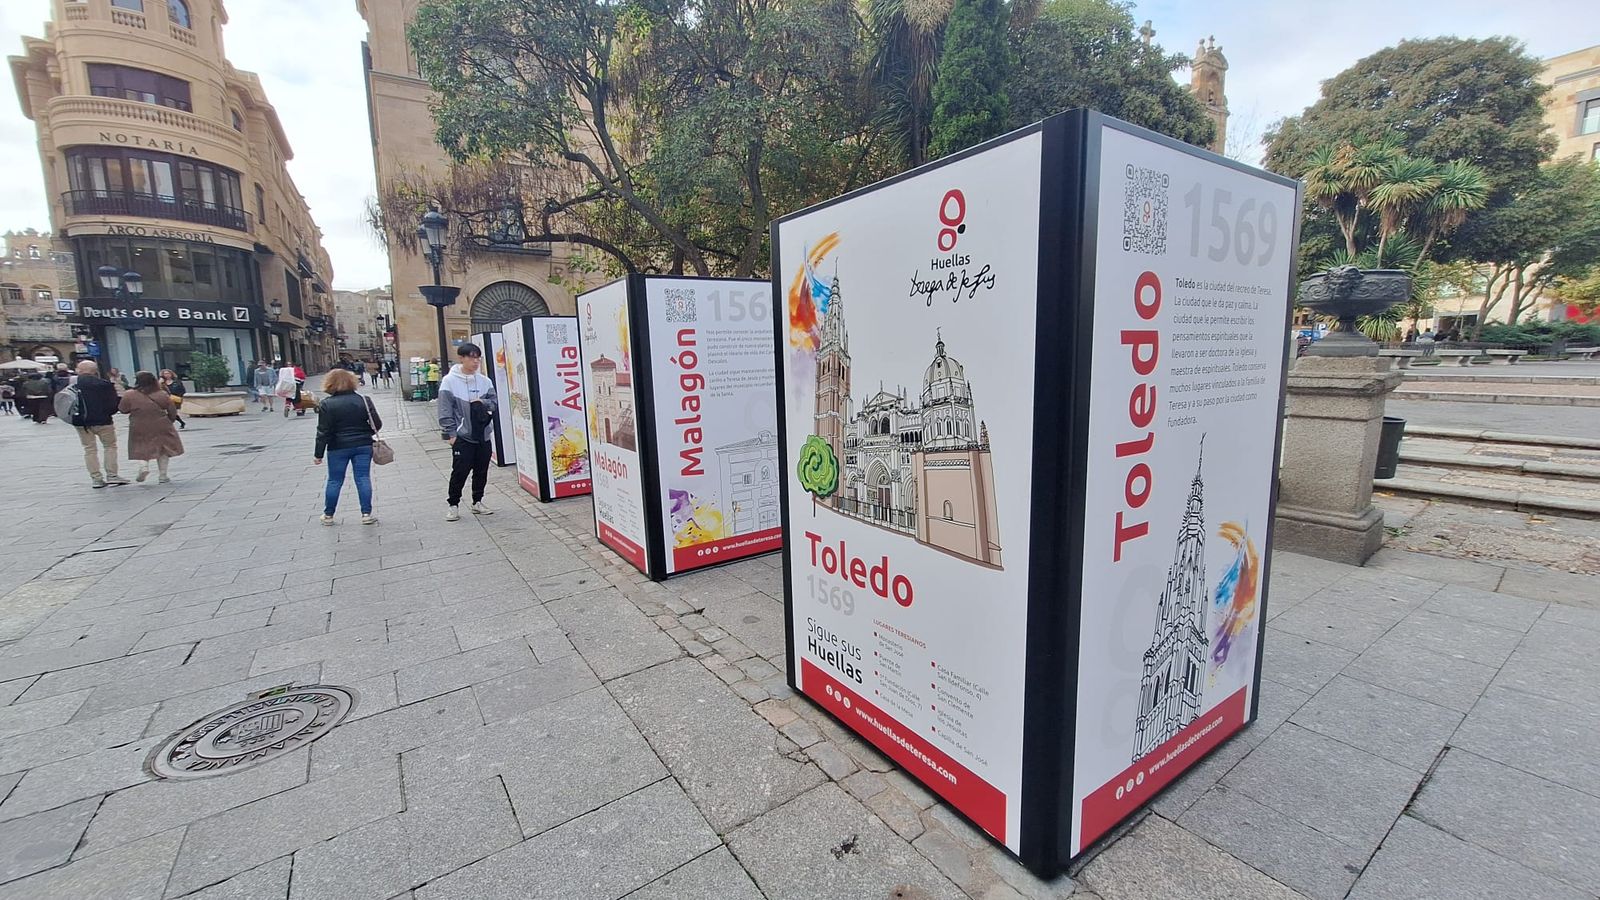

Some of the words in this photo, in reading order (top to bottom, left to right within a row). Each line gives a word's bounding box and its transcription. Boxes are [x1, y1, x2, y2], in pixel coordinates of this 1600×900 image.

[99, 131, 199, 155] NOTARÍA
[107, 225, 146, 236] ARCO
[152, 229, 214, 244] ASESORÍA
[1184, 182, 1278, 267] 1569
[931, 253, 970, 270] Huellas
[1175, 277, 1196, 289] Toledo
[1196, 282, 1203, 290] es
[1209, 280, 1227, 292] ciudad
[1174, 295, 1181, 306] La
[1182, 295, 1200, 307] ciudad
[1201, 299, 1211, 310] que
[83, 306, 170, 319] Deutsche
[177, 307, 228, 321] Bank
[1173, 313, 1192, 324] ciudad
[1193, 316, 1203, 327] que
[1210, 315, 1229, 327] permite
[1172, 331, 1210, 342] pensamientos
[1211, 330, 1238, 342] espirituales
[1171, 346, 1194, 359] llevaron
[1209, 347, 1227, 357] doctora
[554, 346, 583, 412] Ávila
[1170, 366, 1193, 376] maestra
[1169, 382, 1191, 393] muchos
[1192, 380, 1211, 393] lugares
[1212, 378, 1236, 390] vinculados
[670, 328, 705, 477] Malagón
[1168, 400, 1187, 410] Teresa
[1203, 397, 1215, 409] paso
[1113, 270, 1162, 563] Toledo
[1167, 415, 1198, 428] fundadora.
[593, 450, 628, 479] Malagón
[805, 531, 914, 608] Toledo
[806, 573, 855, 616] 1569
[807, 617, 838, 647] Sigue
[841, 639, 862, 661] sus
[873, 618, 895, 633] LUGARES
[895, 628, 927, 649] TERESIANOS
[808, 636, 863, 684] Huellas
[937, 671, 947, 681] San
[937, 664, 950, 676] Casa
[951, 671, 972, 686] Familiar
[973, 682, 989, 696] (Calle
[937, 686, 962, 705] Convento
[948, 700, 974, 719] Clemente
[186, 721, 326, 771] SALAMANCA
[855, 706, 957, 785] www.huellasdeteresa.com
[1149, 716, 1224, 775] www.huellasdeteresa.com
